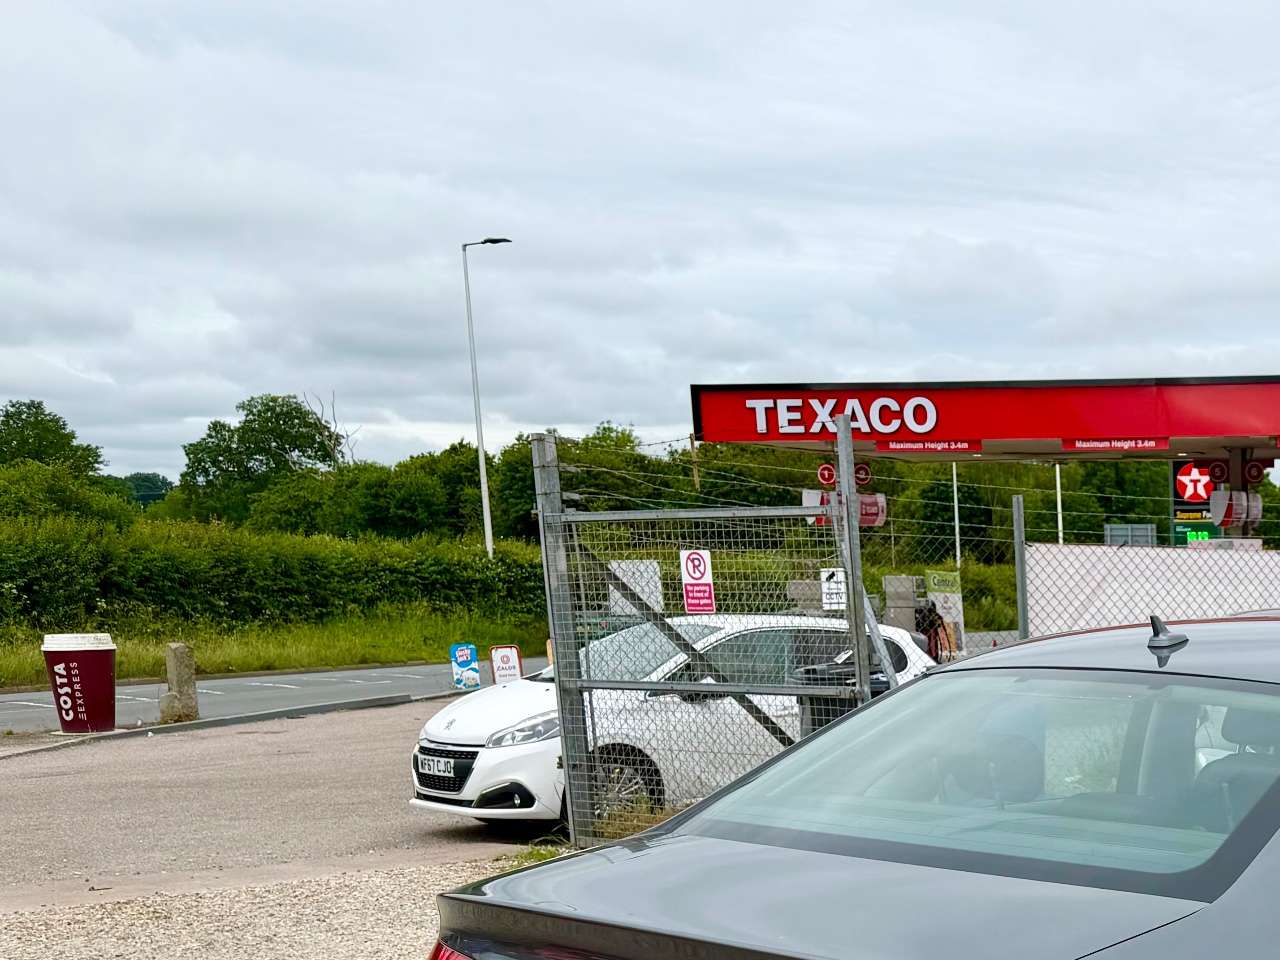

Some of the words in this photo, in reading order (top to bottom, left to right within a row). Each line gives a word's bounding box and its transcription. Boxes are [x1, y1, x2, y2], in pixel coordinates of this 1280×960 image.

[746, 396, 937, 433] TEXACO
[889, 441, 924, 449] Maximum
[924, 441, 949, 450] Height
[949, 441, 969, 449] 3.4m
[1075, 440, 1110, 448] Maximum
[1111, 440, 1136, 449] Height
[1136, 440, 1155, 448] 3.4m
[53, 662, 74, 722] COSTA
[69, 662, 86, 713] EXPRESS
